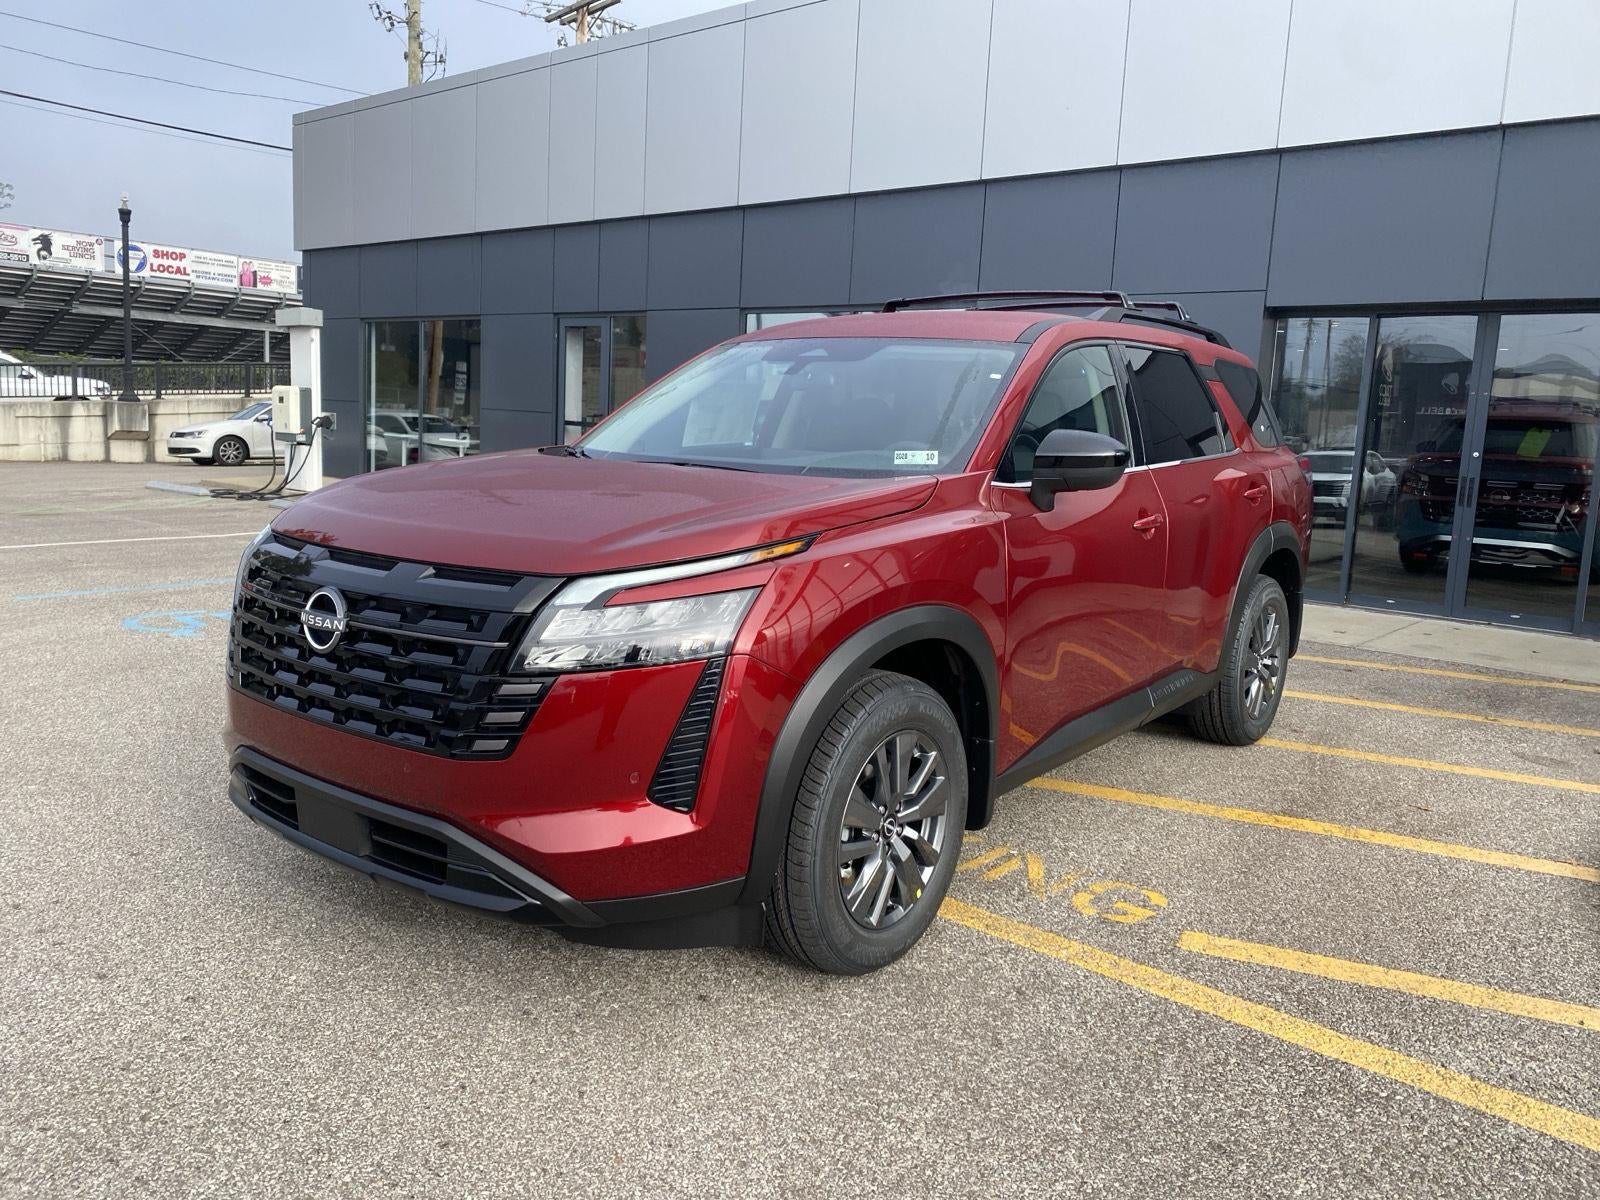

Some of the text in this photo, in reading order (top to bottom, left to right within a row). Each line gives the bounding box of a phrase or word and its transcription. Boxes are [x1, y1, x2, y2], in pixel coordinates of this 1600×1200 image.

[61, 244, 96, 255] SERVING
[76, 240, 95, 248] NOW
[69, 252, 96, 261] LUNCH
[152, 249, 187, 263] SHOP
[149, 263, 191, 277] LOCAL
[926, 452, 935, 461] 10
[300, 611, 344, 631] NISSAN
